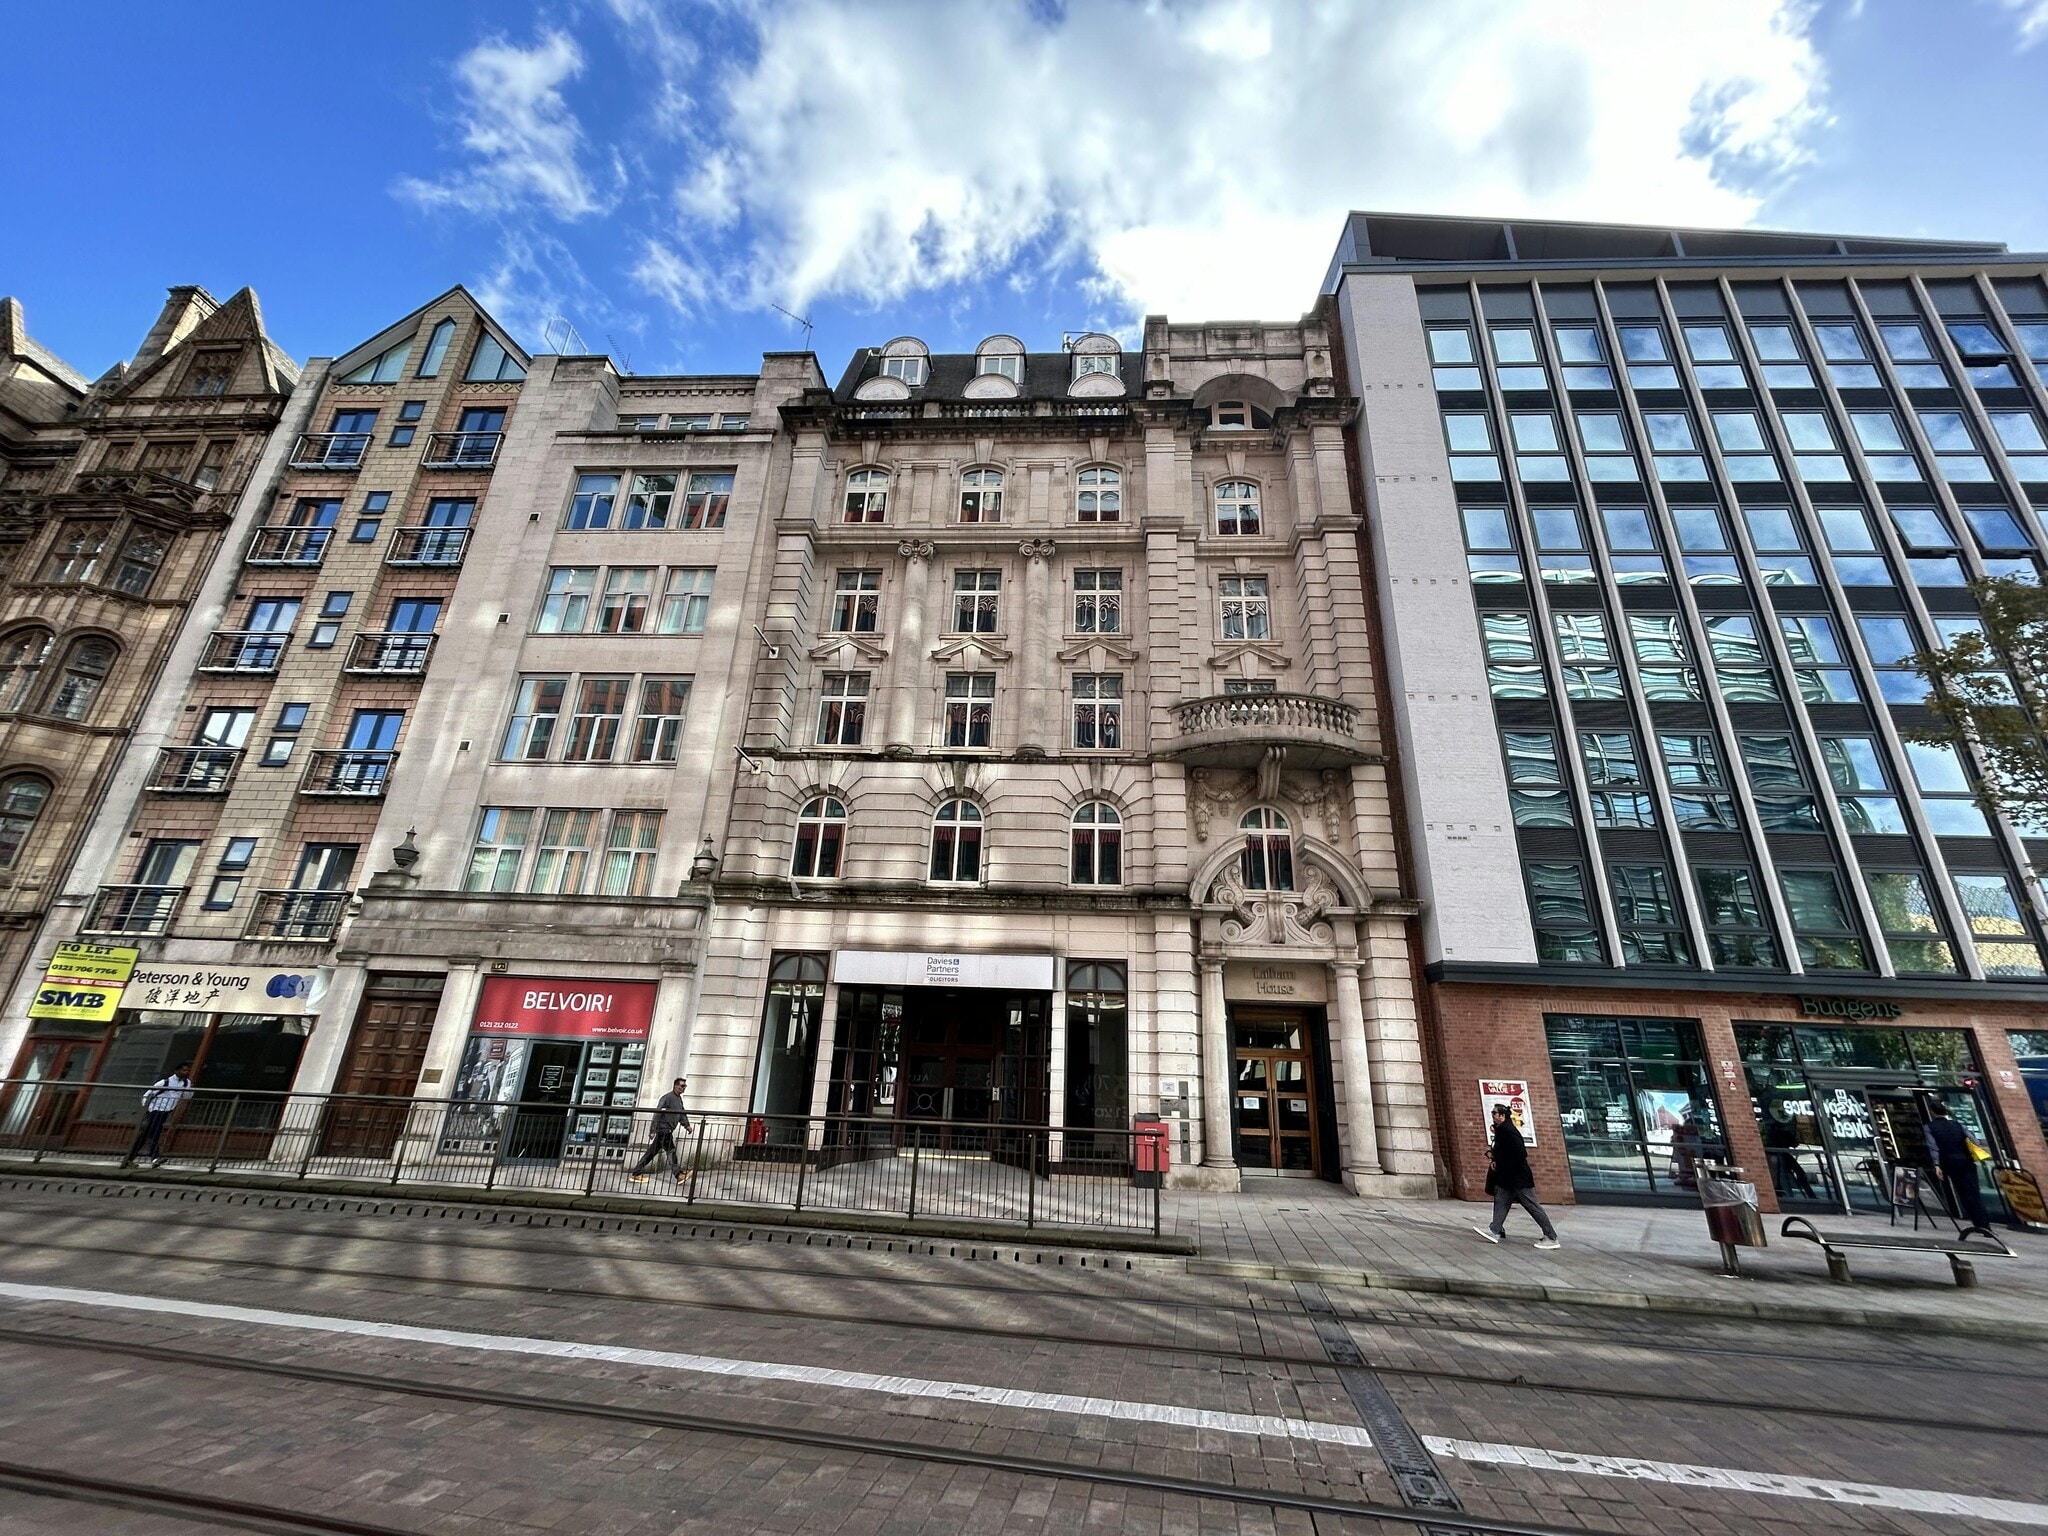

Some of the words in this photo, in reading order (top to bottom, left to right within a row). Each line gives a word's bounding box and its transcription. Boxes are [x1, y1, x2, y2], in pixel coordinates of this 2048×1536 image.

[61, 943, 81, 952] TO
[84, 946, 114, 955] LET
[927, 956, 953, 965] Davies
[94, 967, 118, 975] 7766
[926, 965, 960, 973] Partners
[130, 969, 189, 986] Peterson
[191, 972, 203, 985] &
[205, 972, 250, 991] Young
[1256, 981, 1295, 995] House
[36, 989, 107, 1009] SMB
[522, 991, 613, 1013] BELVOIR!
[1801, 996, 1903, 1020] Budgens
